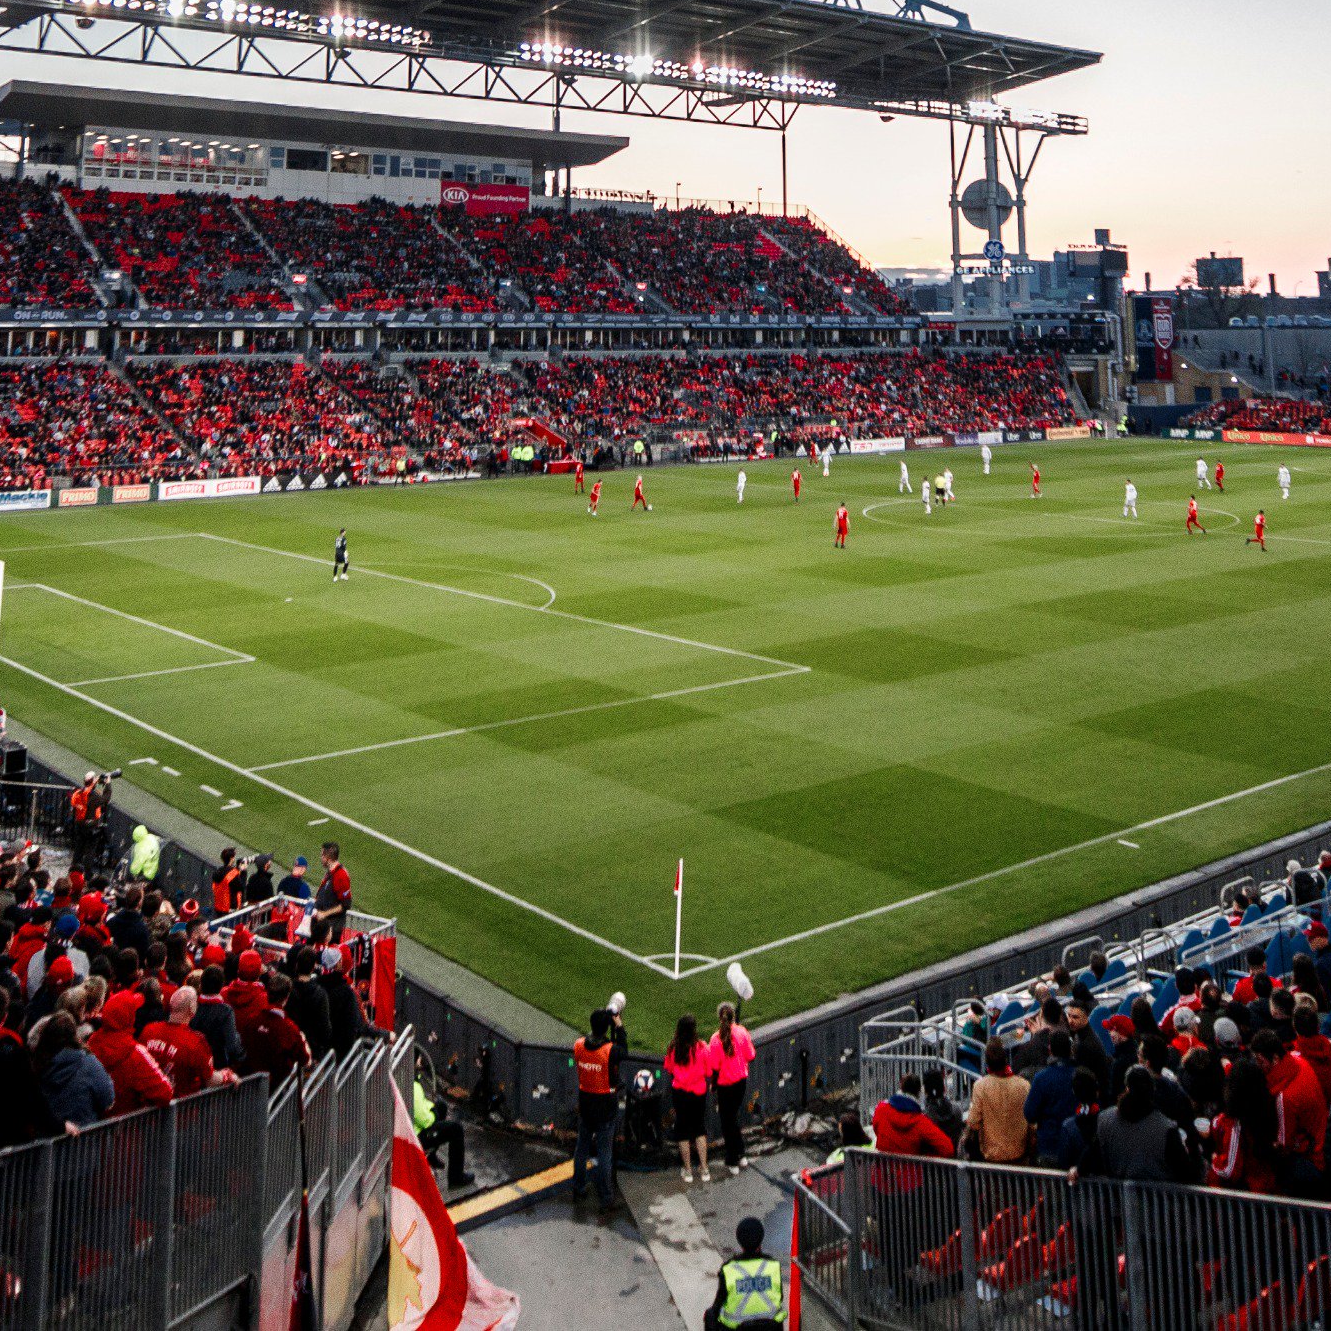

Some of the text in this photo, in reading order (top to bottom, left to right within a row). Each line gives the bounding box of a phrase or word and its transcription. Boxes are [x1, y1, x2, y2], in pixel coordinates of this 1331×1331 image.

[956, 266, 1034, 275] GE APPLIANCES
[14, 311, 30, 319] ON
[61, 491, 96, 504] PRIMO
[116, 487, 148, 500] PRIMO
